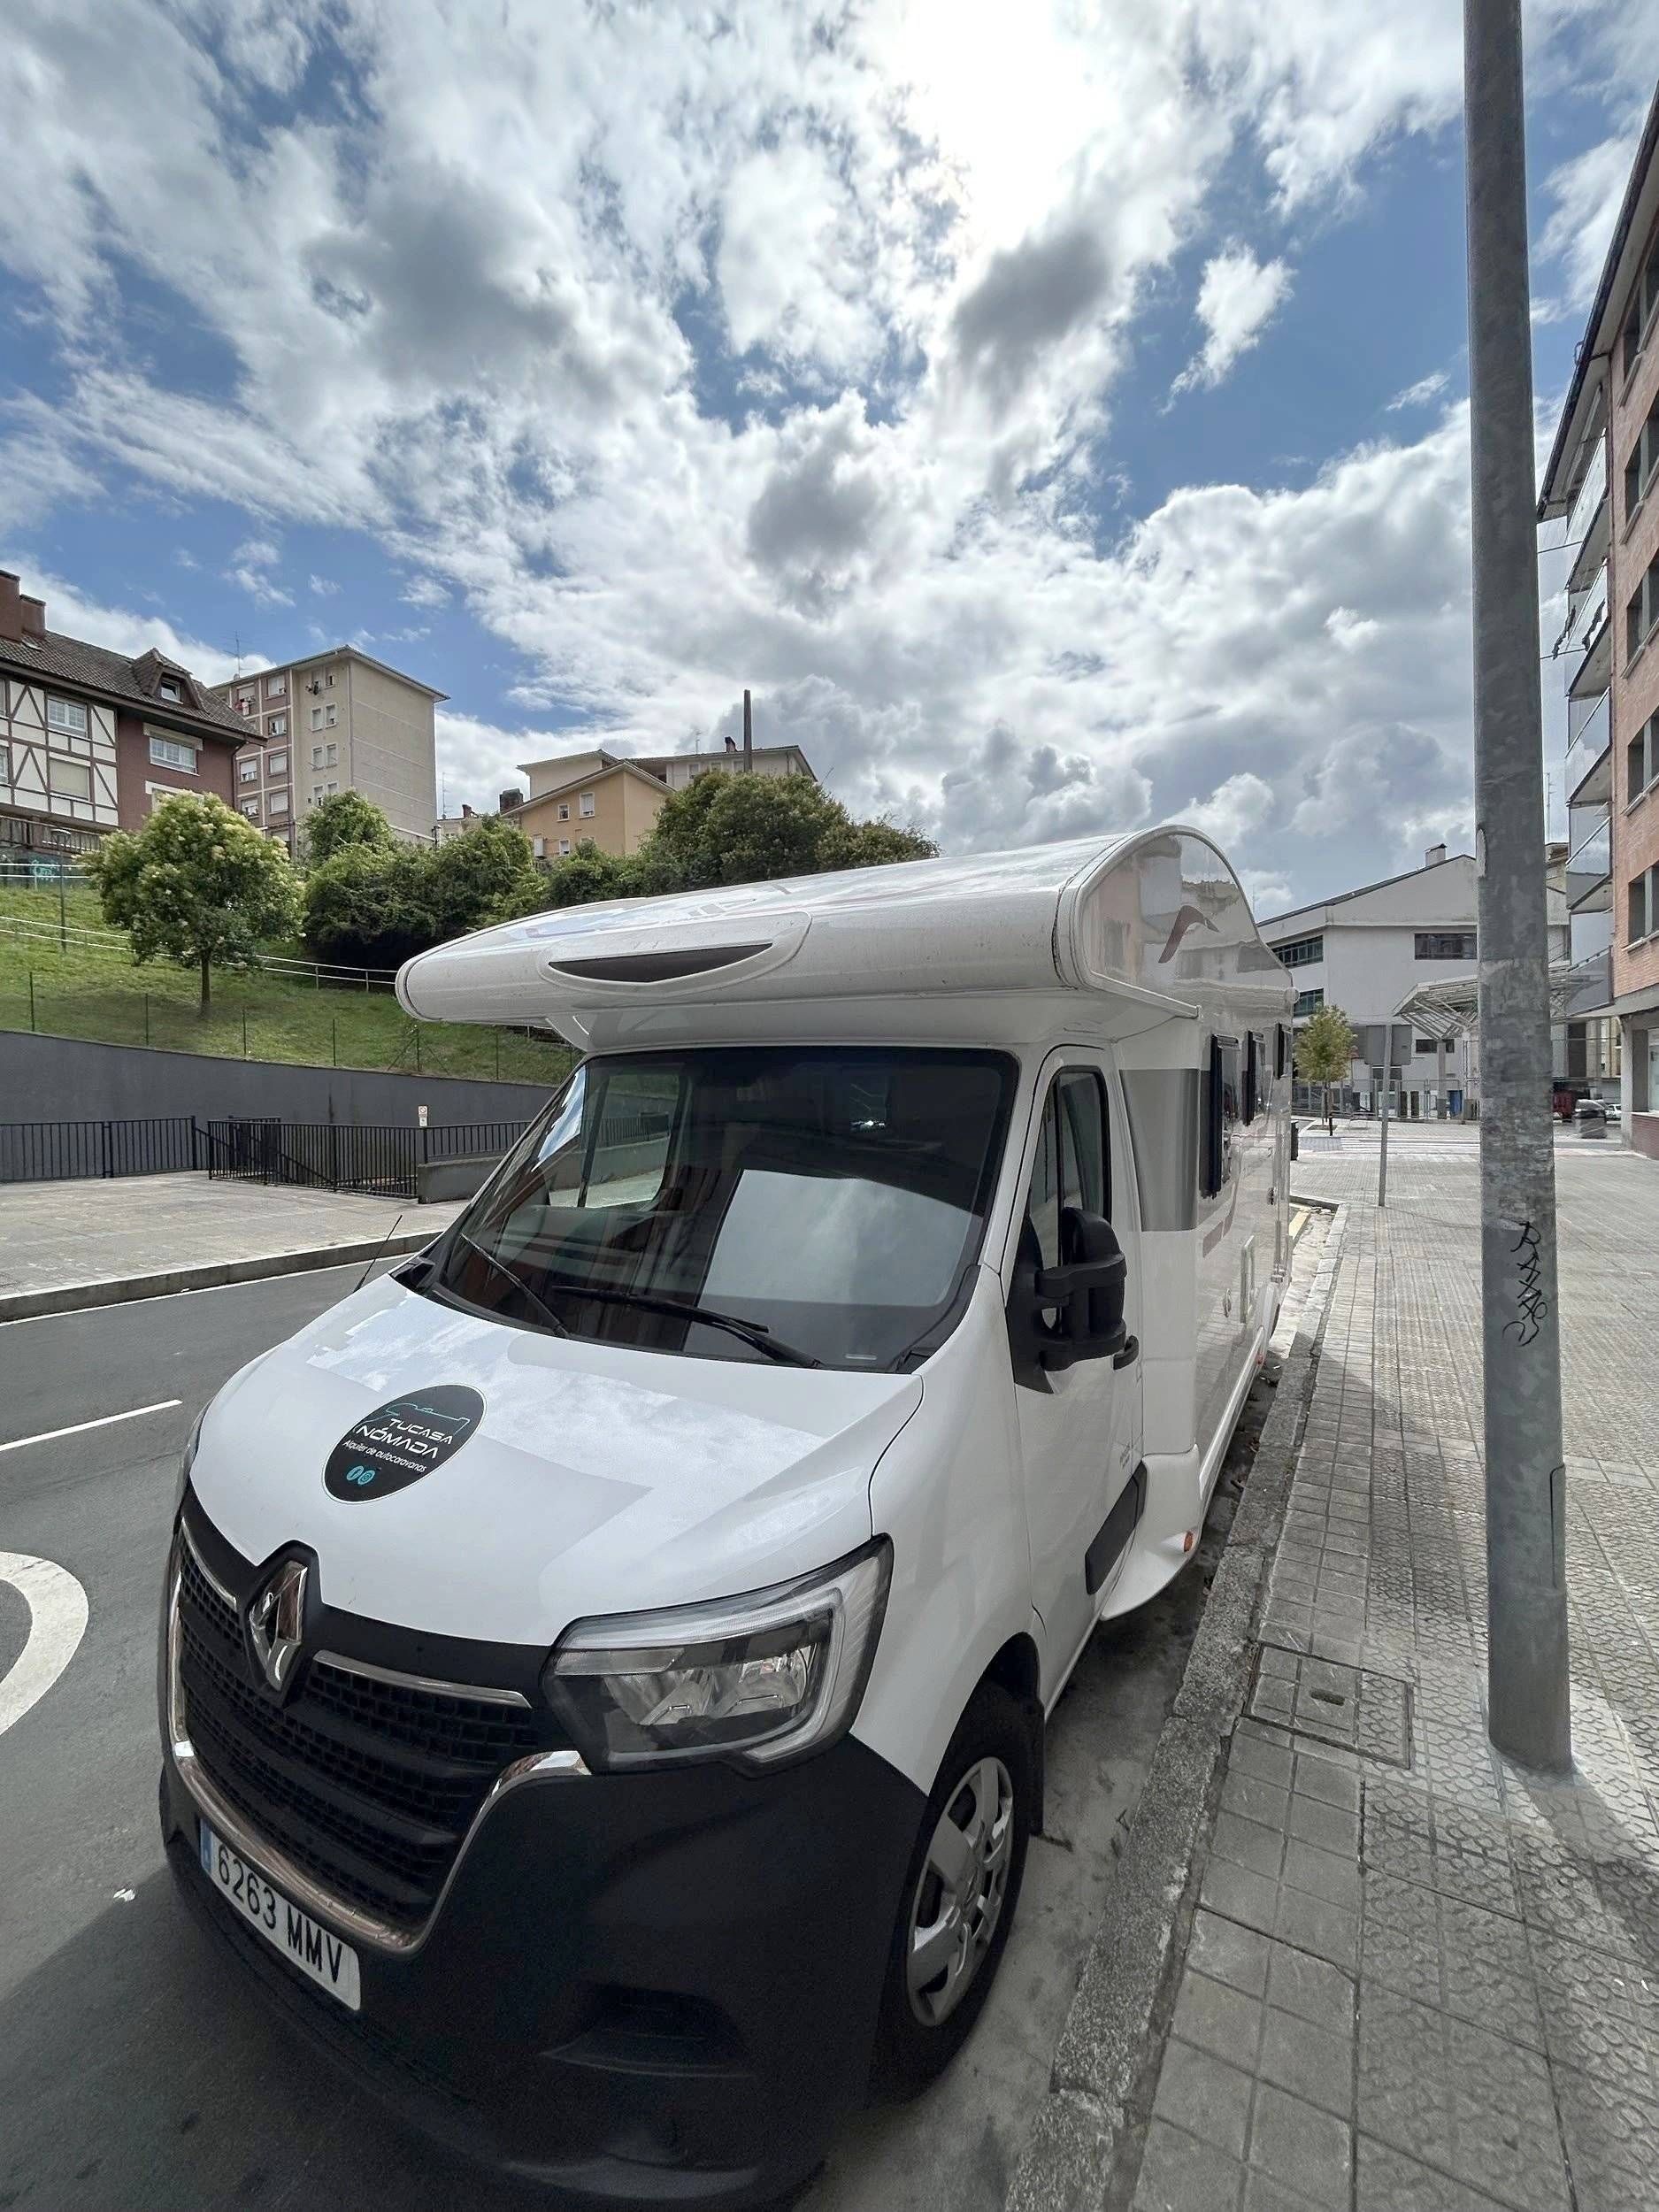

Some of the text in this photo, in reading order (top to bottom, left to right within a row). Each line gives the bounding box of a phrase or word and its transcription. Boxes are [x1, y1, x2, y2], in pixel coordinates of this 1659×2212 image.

[356, 1425, 439, 1459] NÓMADA
[389, 1417, 453, 1445] TUCASA
[365, 1446, 377, 1455] de
[375, 1449, 426, 1472] autocaravanas
[218, 1842, 343, 1984] 6263 MMV
